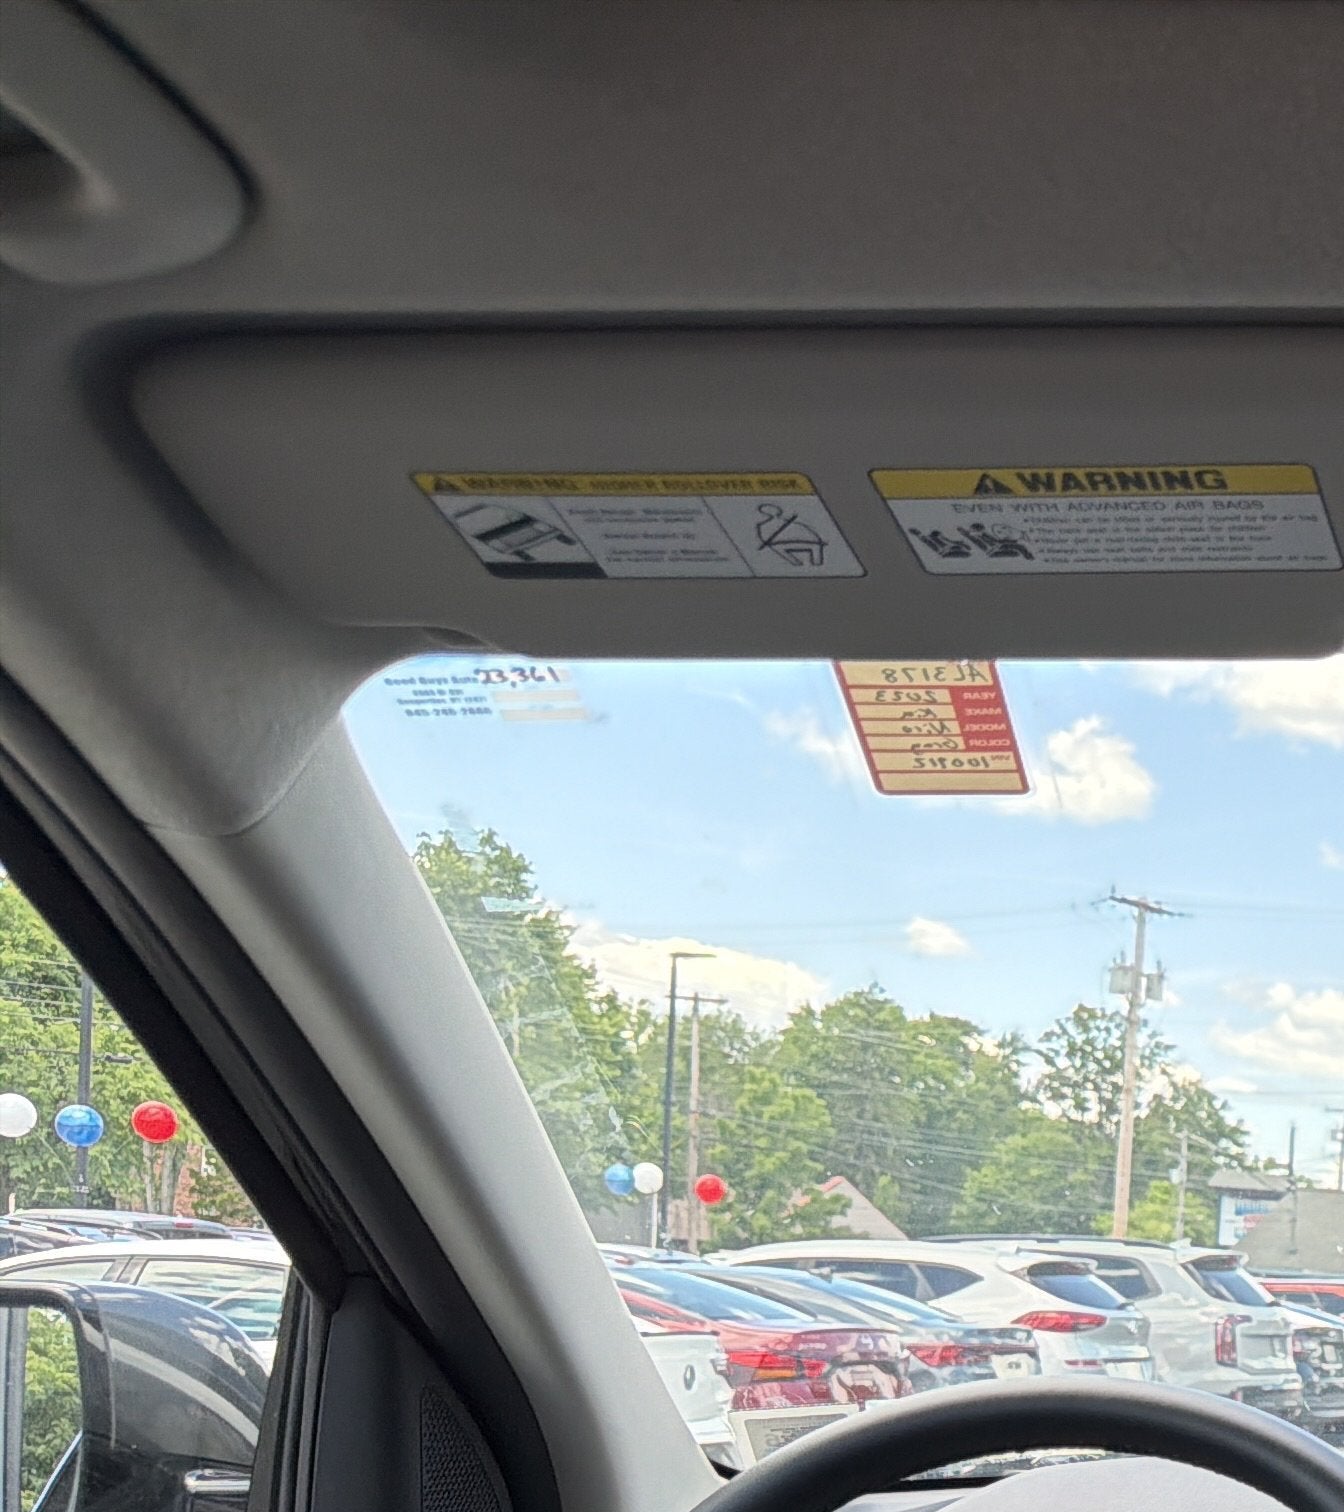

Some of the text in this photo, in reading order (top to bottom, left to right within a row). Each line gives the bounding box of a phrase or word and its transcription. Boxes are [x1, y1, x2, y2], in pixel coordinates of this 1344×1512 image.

[1016, 469, 1228, 493] WARNING
[951, 500, 1265, 513] EVEN WITH ADVANCED AIR BAGS
